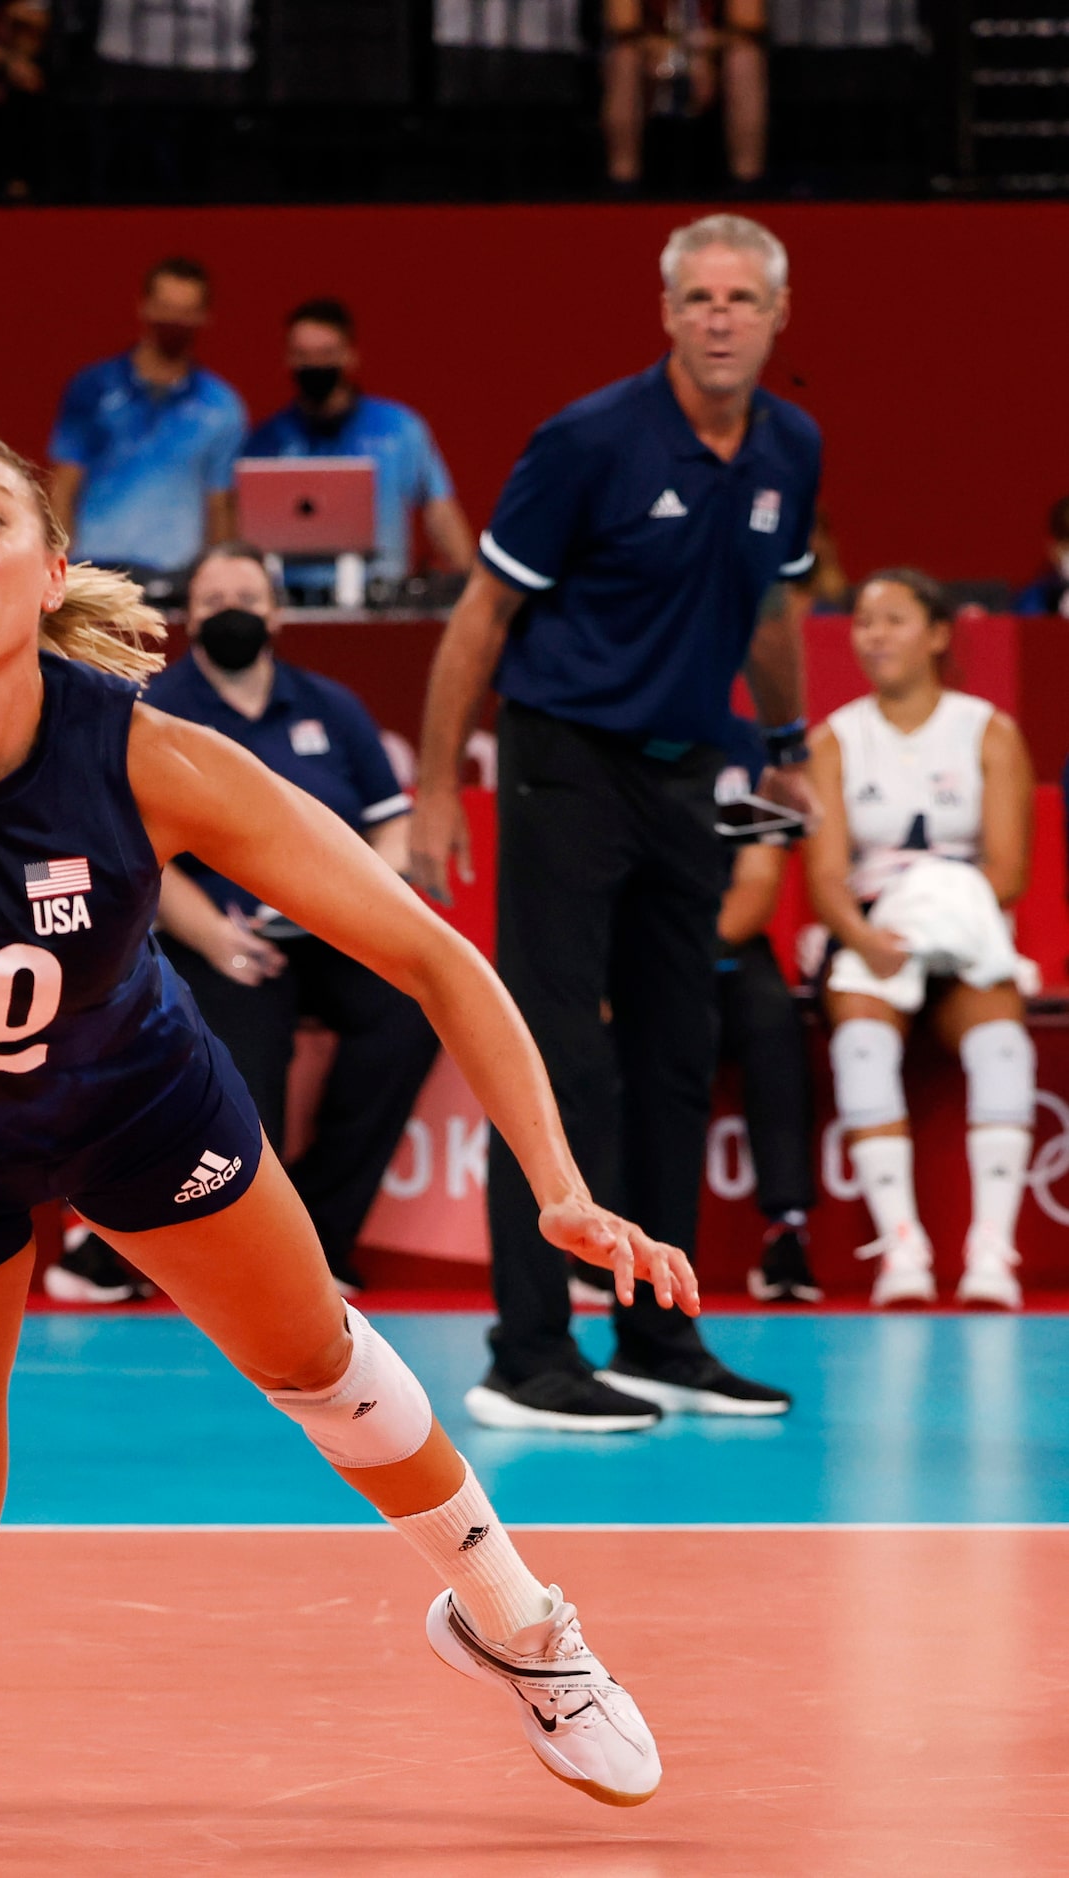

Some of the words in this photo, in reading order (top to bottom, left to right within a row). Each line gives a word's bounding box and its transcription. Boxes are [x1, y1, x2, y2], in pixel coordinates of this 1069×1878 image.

[32, 894, 92, 936] USA
[174, 1155, 242, 1203] adidas
[352, 1400, 377, 1420] adidas
